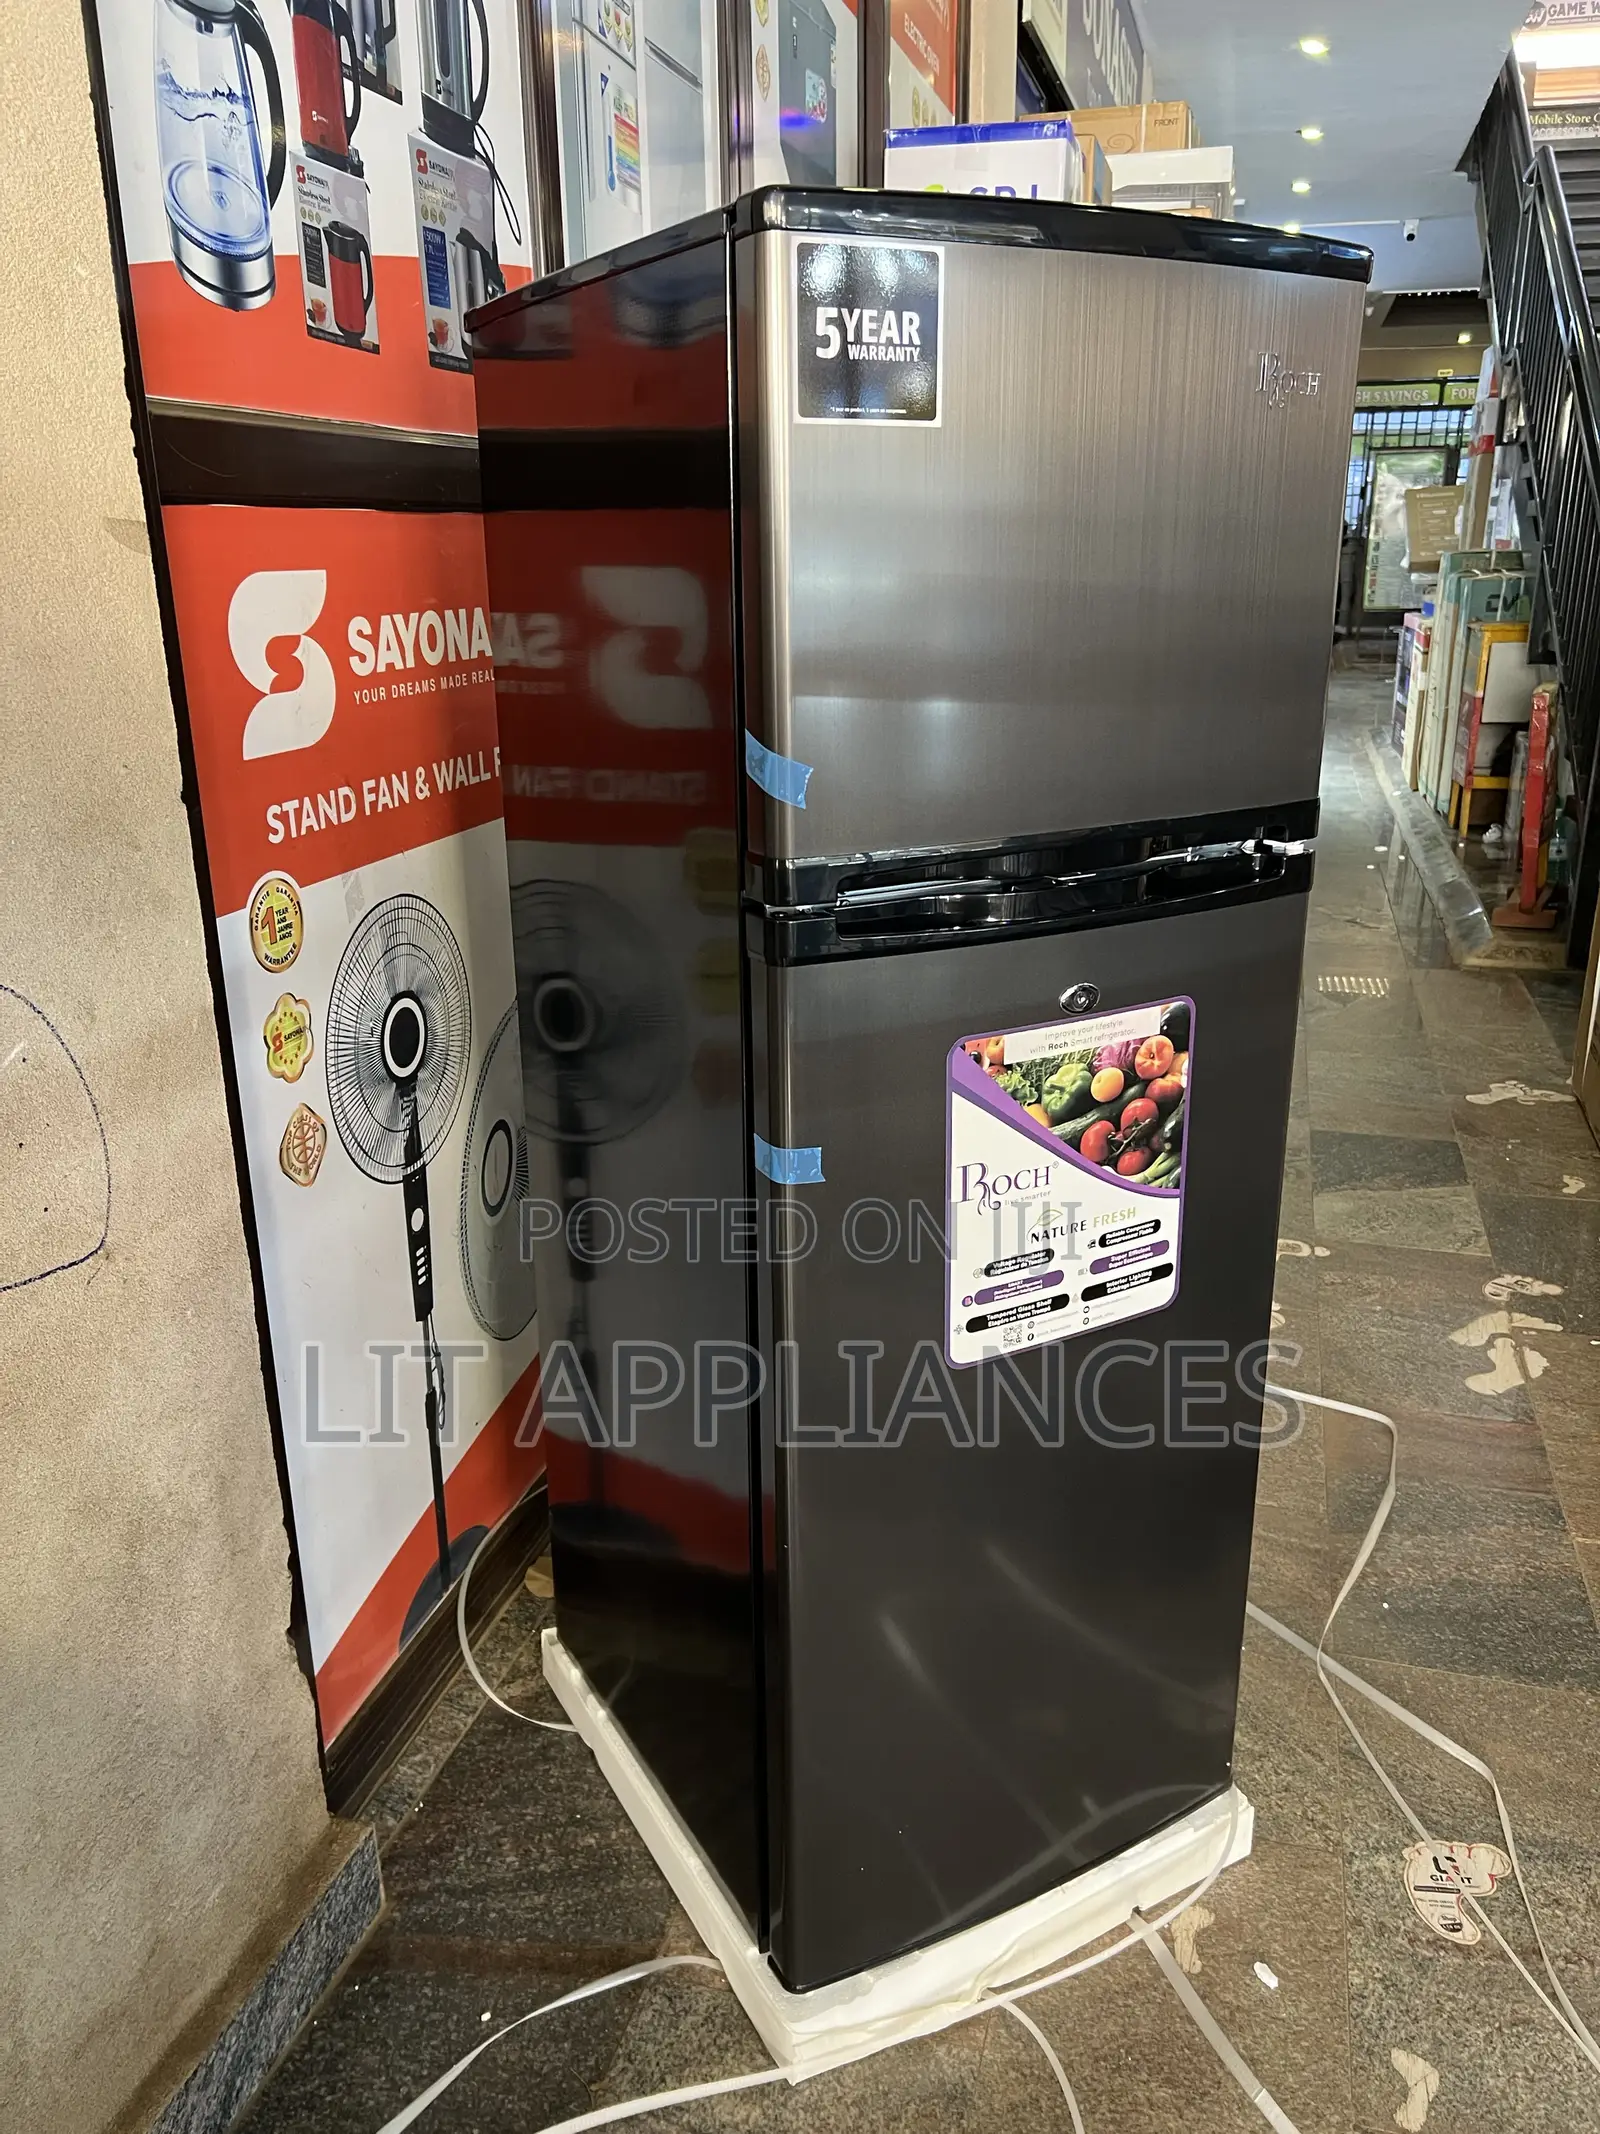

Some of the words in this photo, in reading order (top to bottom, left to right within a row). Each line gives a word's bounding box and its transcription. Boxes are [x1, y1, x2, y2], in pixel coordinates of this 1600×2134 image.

[1548, 2, 1588, 17] GAME
[1154, 116, 1180, 128] FRONT
[1530, 113, 1563, 125] Mobile
[1565, 113, 1592, 124] Store
[815, 306, 841, 360] 5
[840, 307, 921, 346] YEAR
[847, 343, 920, 363] WARRANTY
[1374, 388, 1429, 402] SAVINGS
[347, 606, 493, 677] SAYONA
[353, 683, 387, 705] YOUR
[391, 678, 436, 698] DREAMS
[440, 672, 468, 690] MADE
[266, 785, 357, 844] STAND
[362, 770, 409, 816] FAN
[415, 766, 430, 799] &
[432, 750, 491, 794] WALL
[275, 906, 289, 917] YEAR
[261, 905, 278, 946] 1
[1045, 1027, 1076, 1042] Improve
[1077, 1025, 1094, 1037] your
[1029, 1043, 1047, 1055] with
[1048, 1041, 1069, 1052] Roch
[1070, 1036, 1093, 1048] Smart
[1020, 1190, 1051, 1203] smarter
[1030, 1219, 1088, 1244] NATURE
[1093, 1206, 1136, 1228] FRESH
[986, 1307, 1017, 1321] Tempered
[1017, 1303, 1036, 1313] Glass
[1036, 1298, 1052, 1309] Shelf
